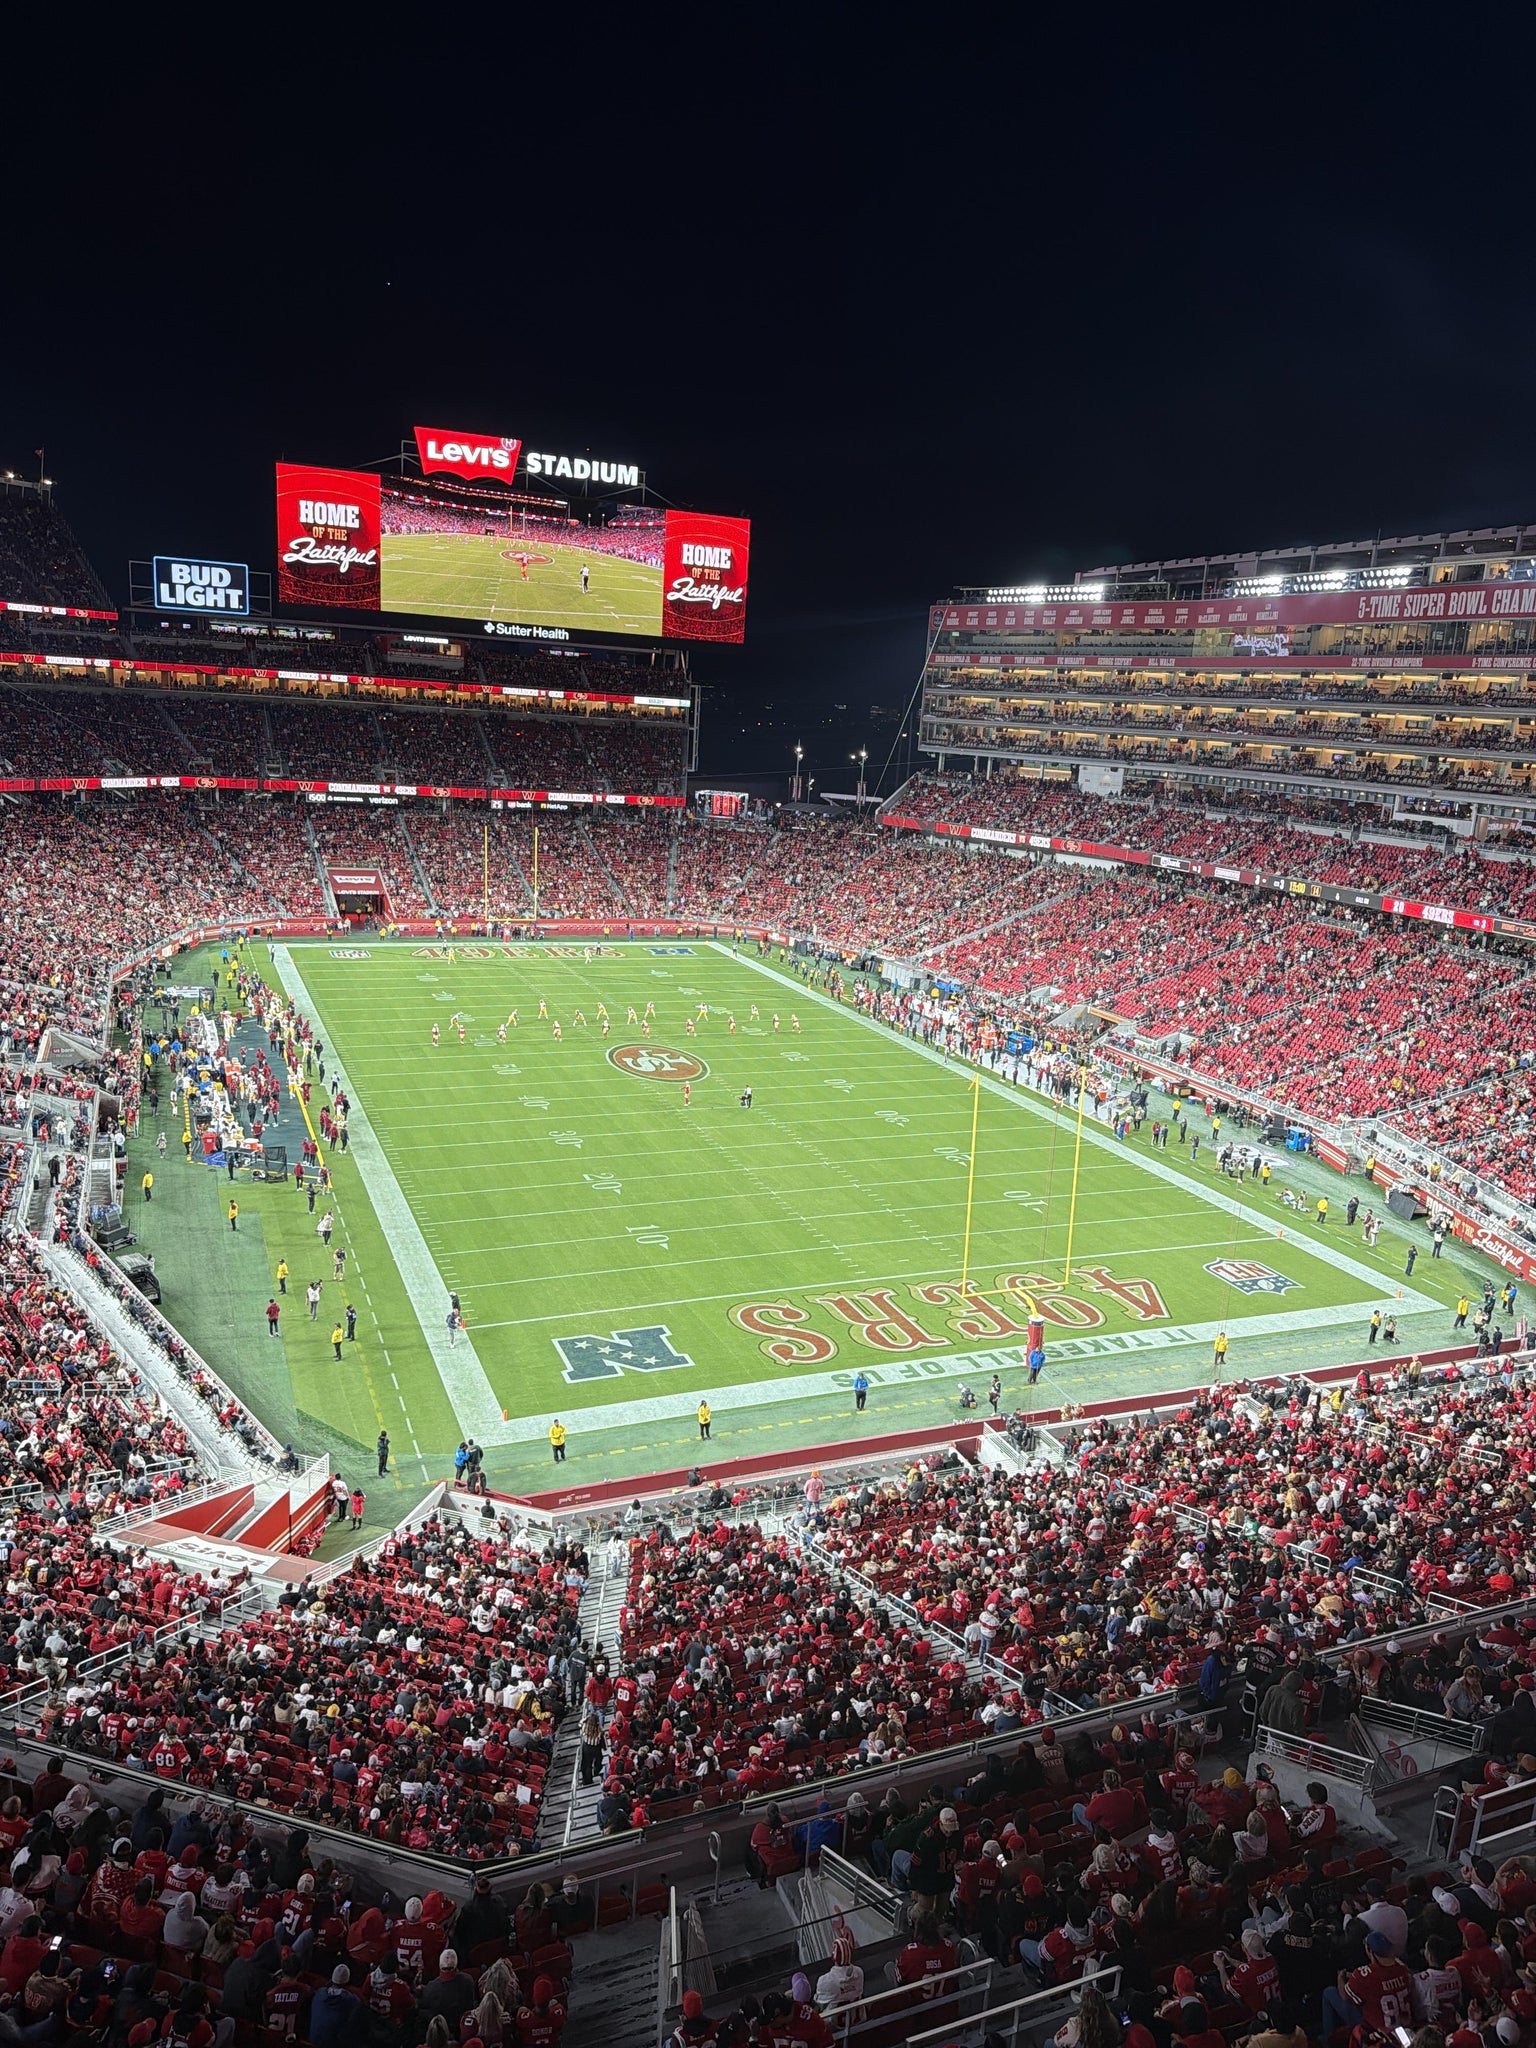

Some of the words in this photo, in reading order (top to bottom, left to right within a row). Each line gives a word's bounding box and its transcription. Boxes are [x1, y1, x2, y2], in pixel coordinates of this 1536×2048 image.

[526, 452, 638, 486] STADIUM
[299, 500, 360, 528] HOME
[312, 527, 325, 539] OF
[327, 528, 348, 541] THE
[282, 537, 377, 573] Faithful
[682, 543, 732, 570] HOME
[171, 563, 231, 587] BUD
[691, 567, 703, 579] OF
[705, 568, 720, 581] THE
[160, 583, 242, 609] LIGHT
[666, 577, 743, 610] Faithful
[1358, 596, 1401, 619] 5-TIME
[1403, 592, 1446, 617] SUPER
[1448, 590, 1487, 616] BOWL
[1491, 588, 1536, 614] CHAM
[496, 624, 532, 637] Sutter
[533, 626, 570, 641] Health
[1372, 658, 1393, 667] DIVISION
[1393, 657, 1423, 667] CHAMPIONS
[1493, 658, 1531, 667] CONFERENCE
[1422, 906, 1455, 925] 49ERS
[549, 1130, 583, 1145] 30
[933, 1146, 971, 1165] 20
[583, 1172, 622, 1189] 20
[1003, 1190, 1048, 1210] 10
[625, 1224, 669, 1244] 10
[1462, 1222, 1475, 1239] THE
[1472, 1229, 1524, 1270] Faithful
[1160, 1328, 1197, 1343] IT
[894, 1360, 940, 1380] OF
[481, 1615, 488, 1624] 5
[730, 1638, 740, 1651] 5
[617, 1689, 630, 1701] 80
[106, 1726, 118, 1739] 13
[155, 1752, 175, 1768] 80
[236, 1781, 253, 1799] 23
[282, 1908, 300, 1935] 21
[397, 1948, 423, 1970] 54
[926, 1959, 942, 1969] BOSA
[274, 1992, 299, 2003] TAYLOR
[268, 2013, 296, 2035] 21
